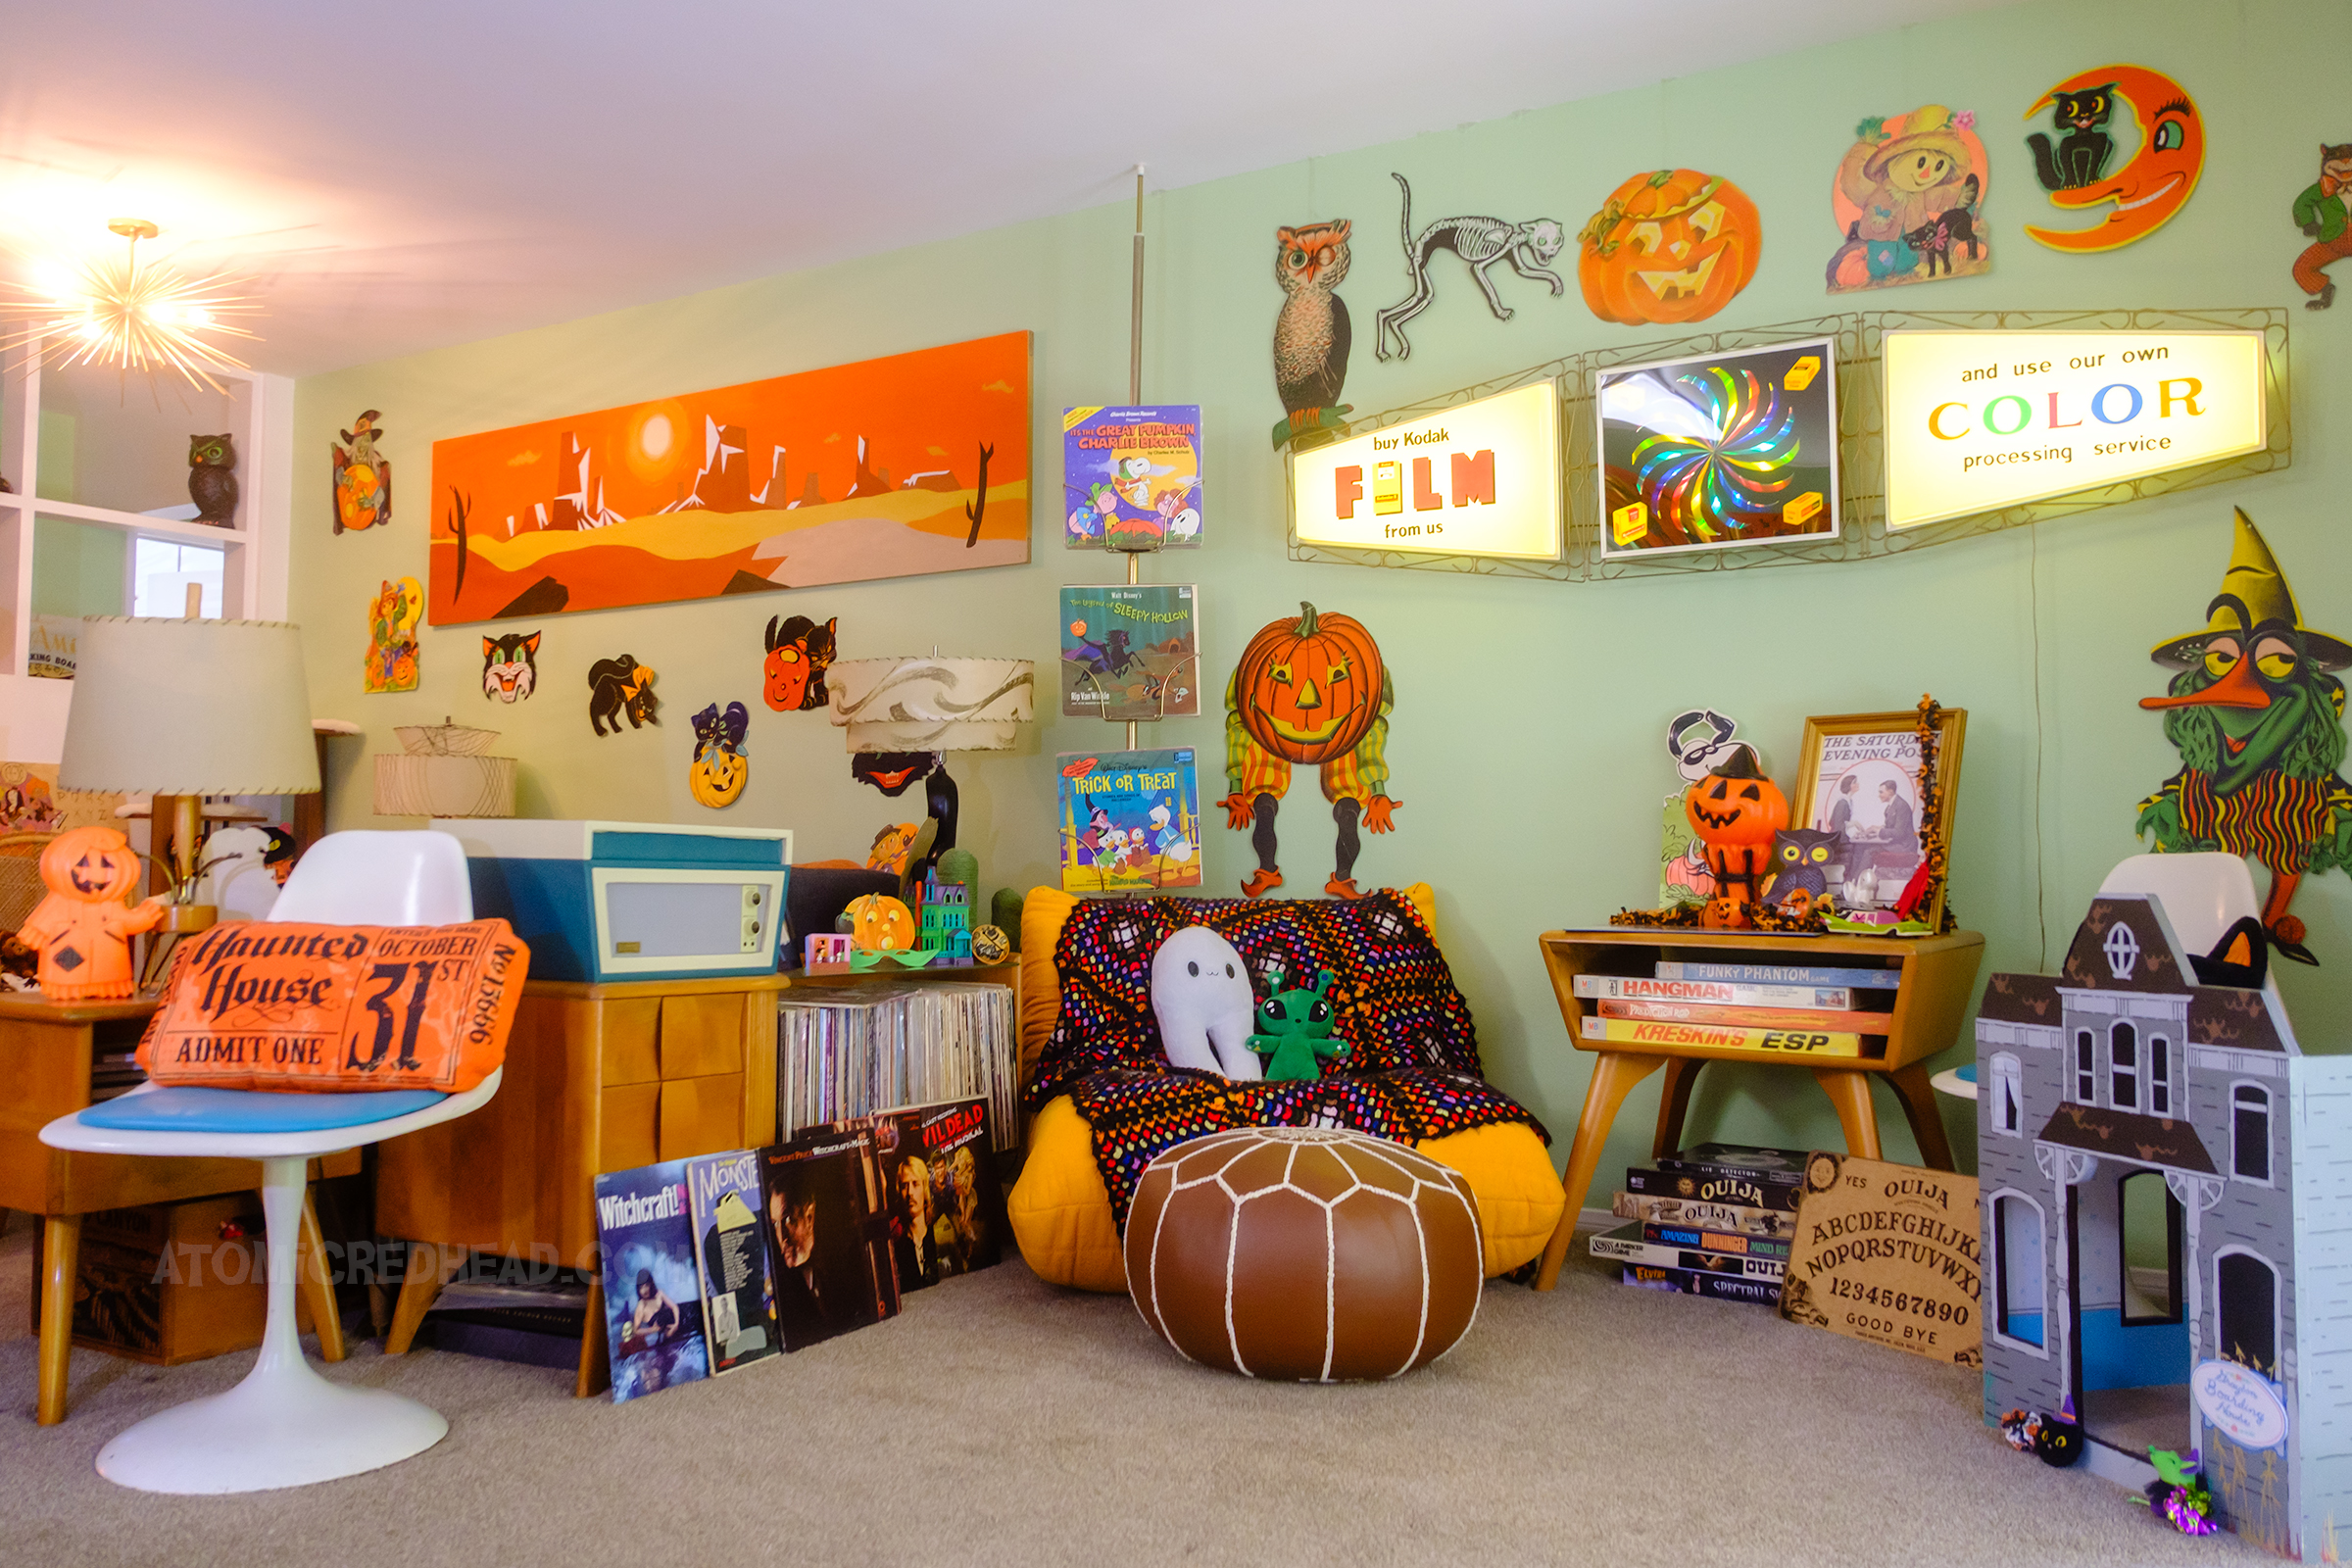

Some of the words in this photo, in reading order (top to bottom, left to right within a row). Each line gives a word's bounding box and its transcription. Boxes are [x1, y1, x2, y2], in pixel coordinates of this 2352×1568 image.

[1962, 364, 1998, 382] and
[2013, 359, 2052, 376] use
[2070, 353, 2106, 370] our
[2122, 345, 2169, 364] own
[1928, 376, 2207, 441] COLOR
[1078, 436, 1139, 450] CHARLIE
[1139, 435, 1190, 449] BROWN
[1096, 424, 1138, 437] GREAT
[1373, 437, 1399, 450] buy
[1403, 427, 1449, 447] Kodak
[1963, 444, 2073, 472] processing
[2093, 434, 2172, 456] service
[1385, 524, 1421, 538] from
[1427, 522, 1444, 534] us
[1113, 603, 1151, 621] SLEEPY
[1151, 610, 1189, 623] HOLLOW
[1822, 748, 1891, 761] EVENING
[1894, 747, 1923, 759] PO
[1824, 736, 1852, 748] THE
[1856, 734, 1919, 749] SATURD
[191, 925, 368, 975] Haunted
[377, 935, 479, 958] OCTOBER
[1698, 965, 1740, 980] FUNKY
[1743, 966, 1810, 982] PHANTOM
[200, 961, 334, 1025] House
[1623, 980, 1735, 1000] HANGMAN
[1629, 1004, 1674, 1017] PREDICTION
[1674, 1007, 1690, 1018] ROD
[175, 1036, 268, 1065] ADMIT
[272, 1036, 325, 1064] ONE
[1632, 1023, 1748, 1047] KRESKIN'S
[1760, 1032, 1831, 1052] ESP
[922, 1123, 946, 1148] VIL
[945, 1103, 984, 1138] DEAD
[699, 1153, 760, 1218] MONSTE
[1700, 1179, 1764, 1208] OUIJA
[1845, 1175, 1867, 1189] YES
[1885, 1179, 1949, 1210] OUIJA
[598, 1183, 680, 1232] Witchcraft!
[1685, 1204, 1739, 1229] OUIJA
[1660, 1229, 1700, 1245] AMAZING
[1701, 1231, 1748, 1253] DUNNINGER
[1749, 1241, 1774, 1254] MIND
[1775, 1244, 1788, 1255] RE
[1745, 1259, 1787, 1276] OUIJ
[1713, 1280, 1765, 1298] SPECTRAL
[1830, 1276, 1969, 1325] 1234567890
[1846, 1312, 1893, 1333] GOOD
[1903, 1325, 1937, 1345] BYE
[2204, 1377, 2266, 1427] Boarding
